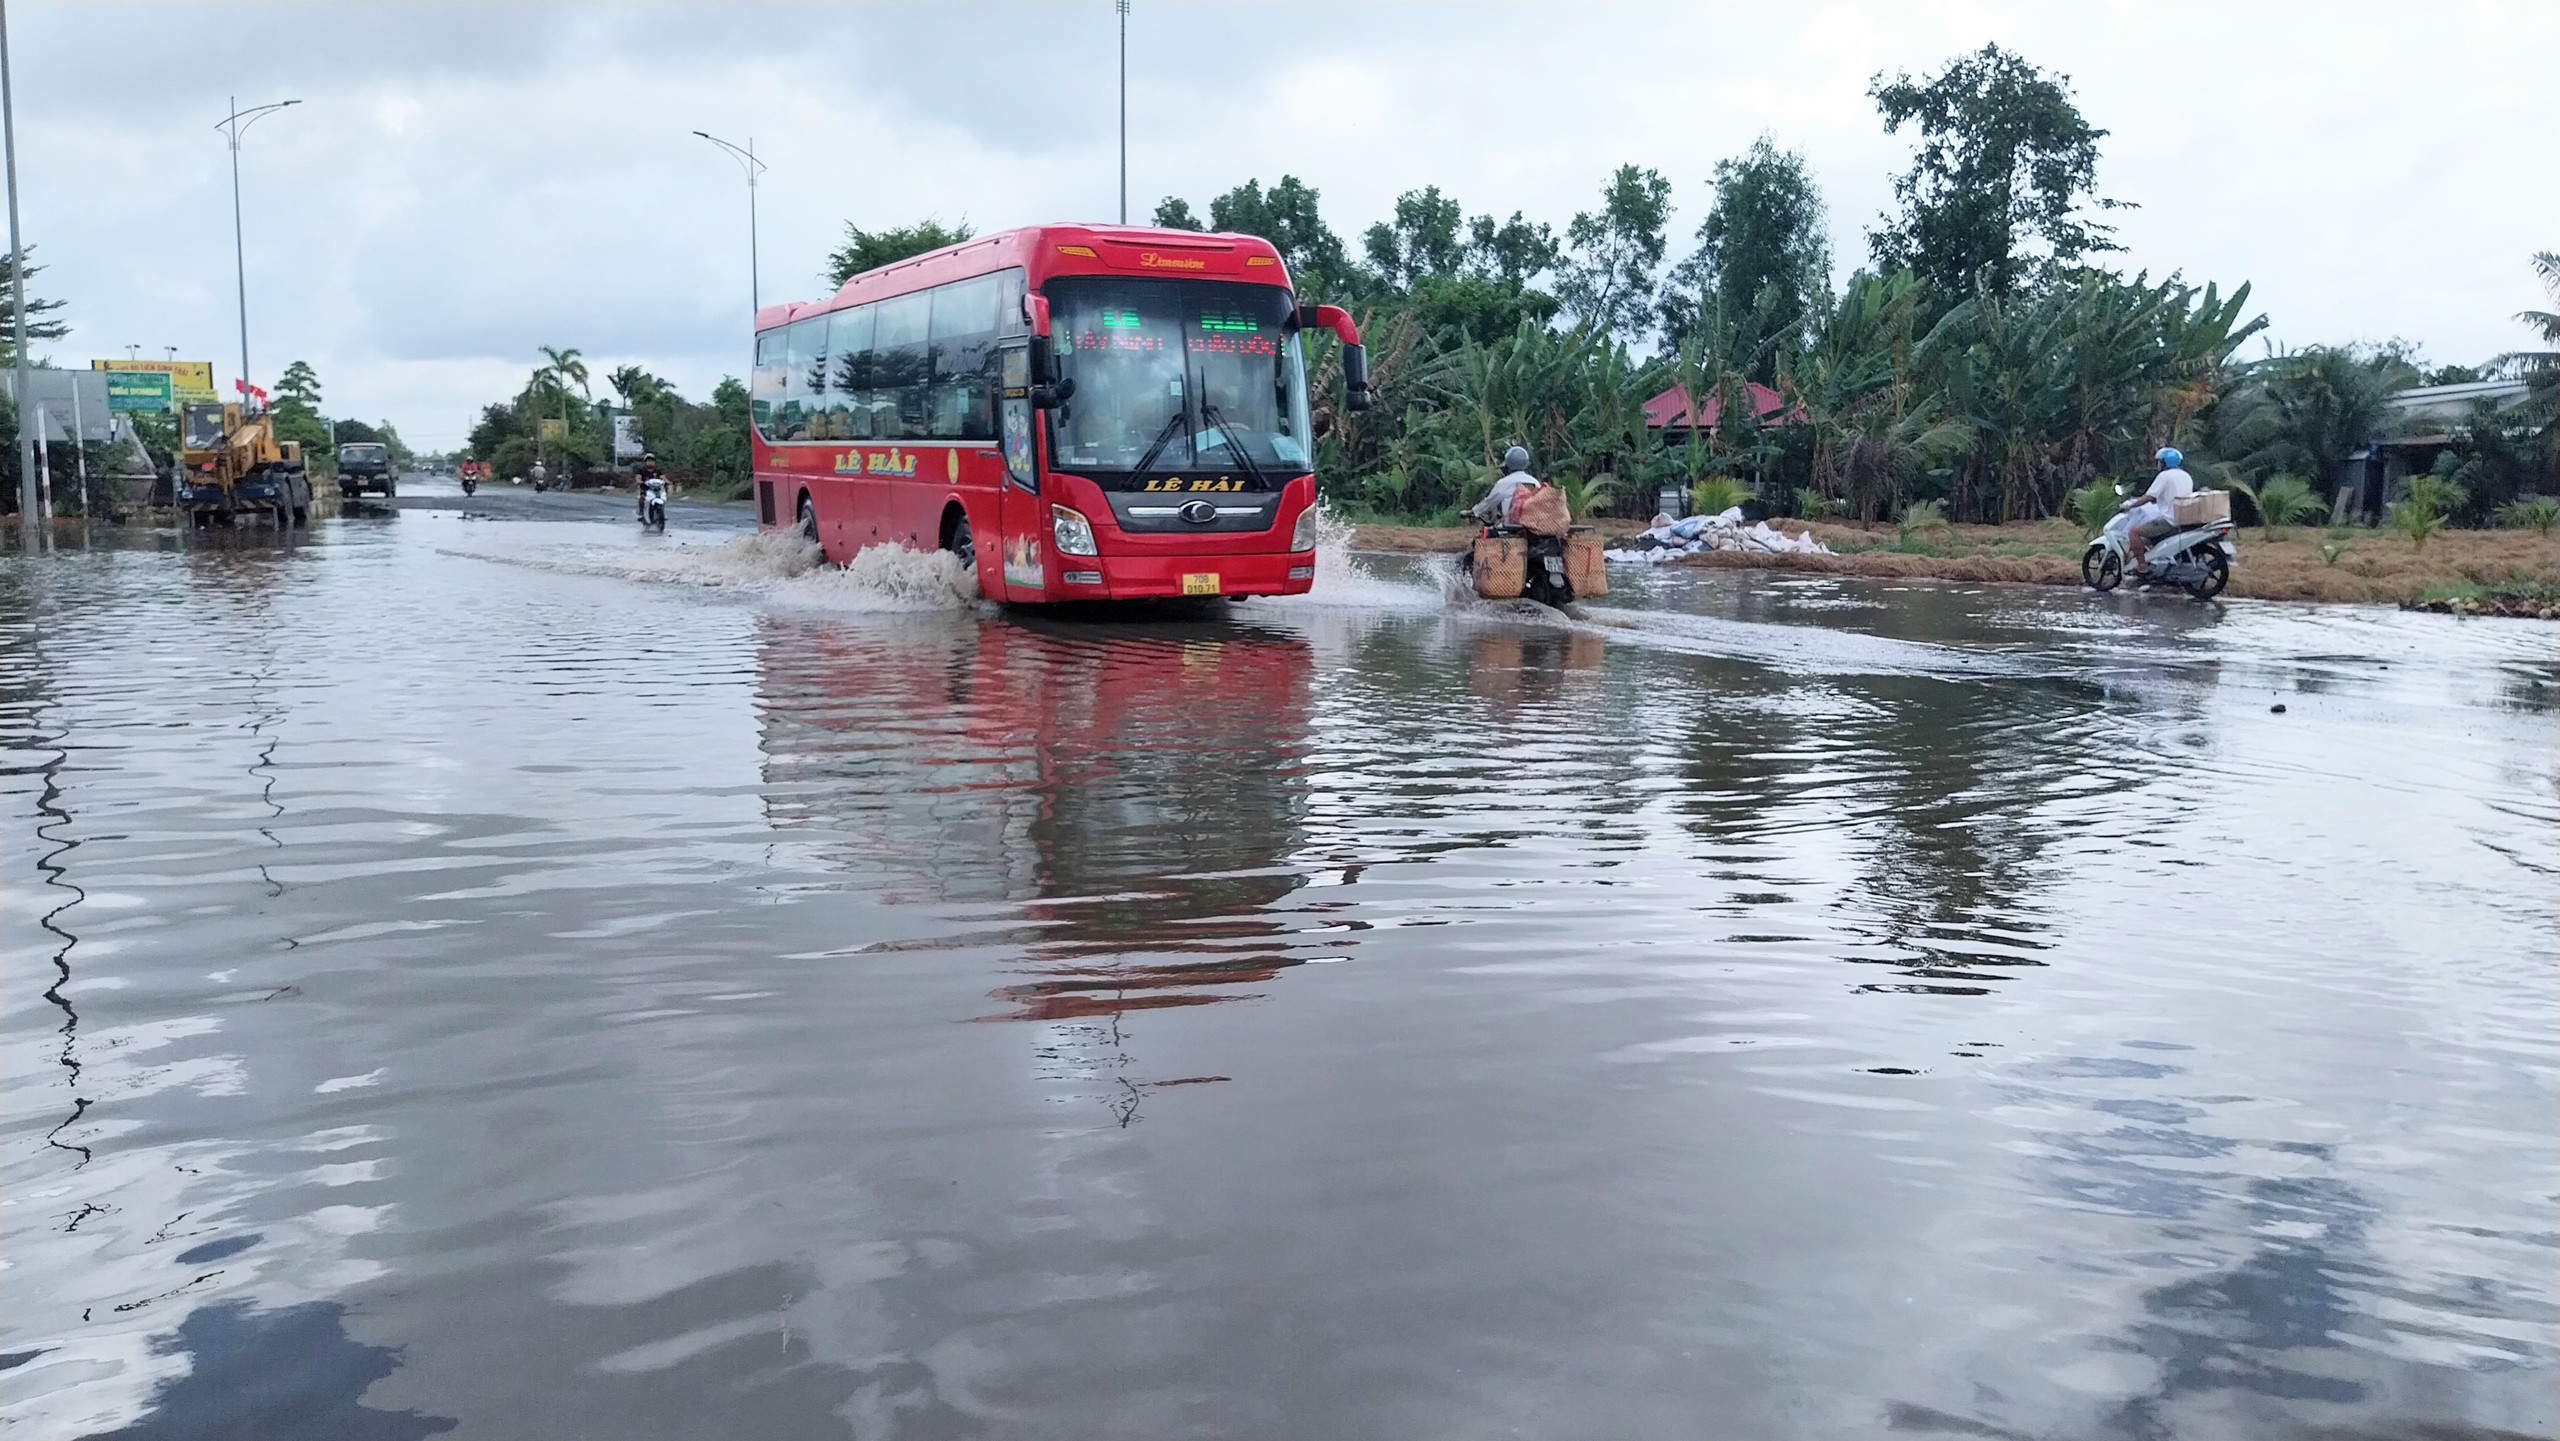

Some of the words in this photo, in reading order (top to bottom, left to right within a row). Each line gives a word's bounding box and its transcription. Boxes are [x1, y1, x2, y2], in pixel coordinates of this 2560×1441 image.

[1140, 253, 1205, 269] Limousine
[834, 450, 863, 473] LÊ
[867, 448, 917, 477] HẢI
[1144, 477, 1183, 491] LÊ
[1189, 476, 1246, 491] HẢI
[1193, 574, 1210, 584] 70B
[1187, 584, 1217, 594] 010.71
